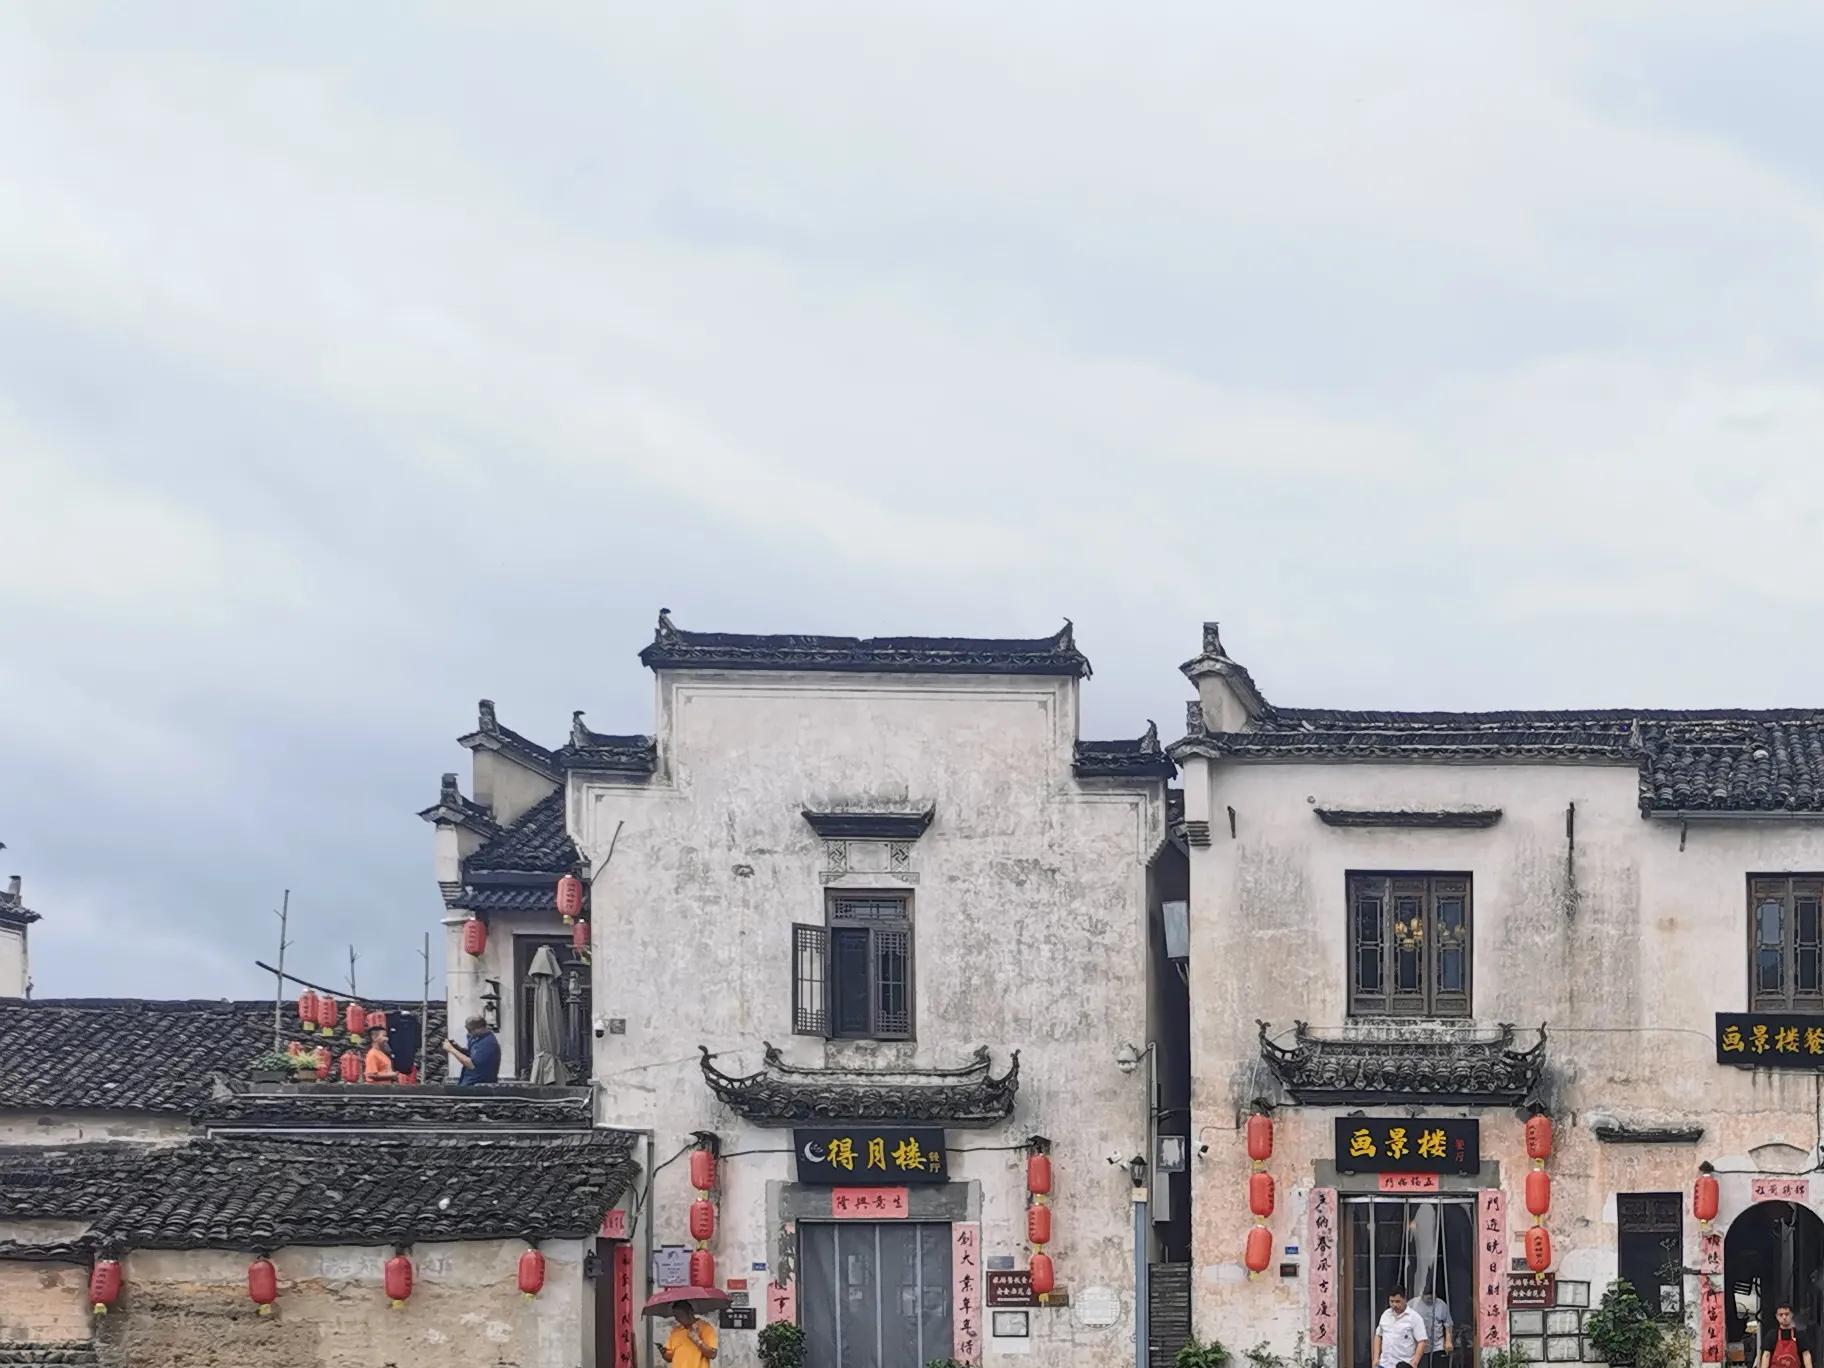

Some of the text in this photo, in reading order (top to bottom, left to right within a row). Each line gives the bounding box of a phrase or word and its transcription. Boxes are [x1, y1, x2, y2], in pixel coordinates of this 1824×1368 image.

[827, 1136, 928, 1171] 得月楼
[1350, 1127, 1447, 1160] 画景楼
